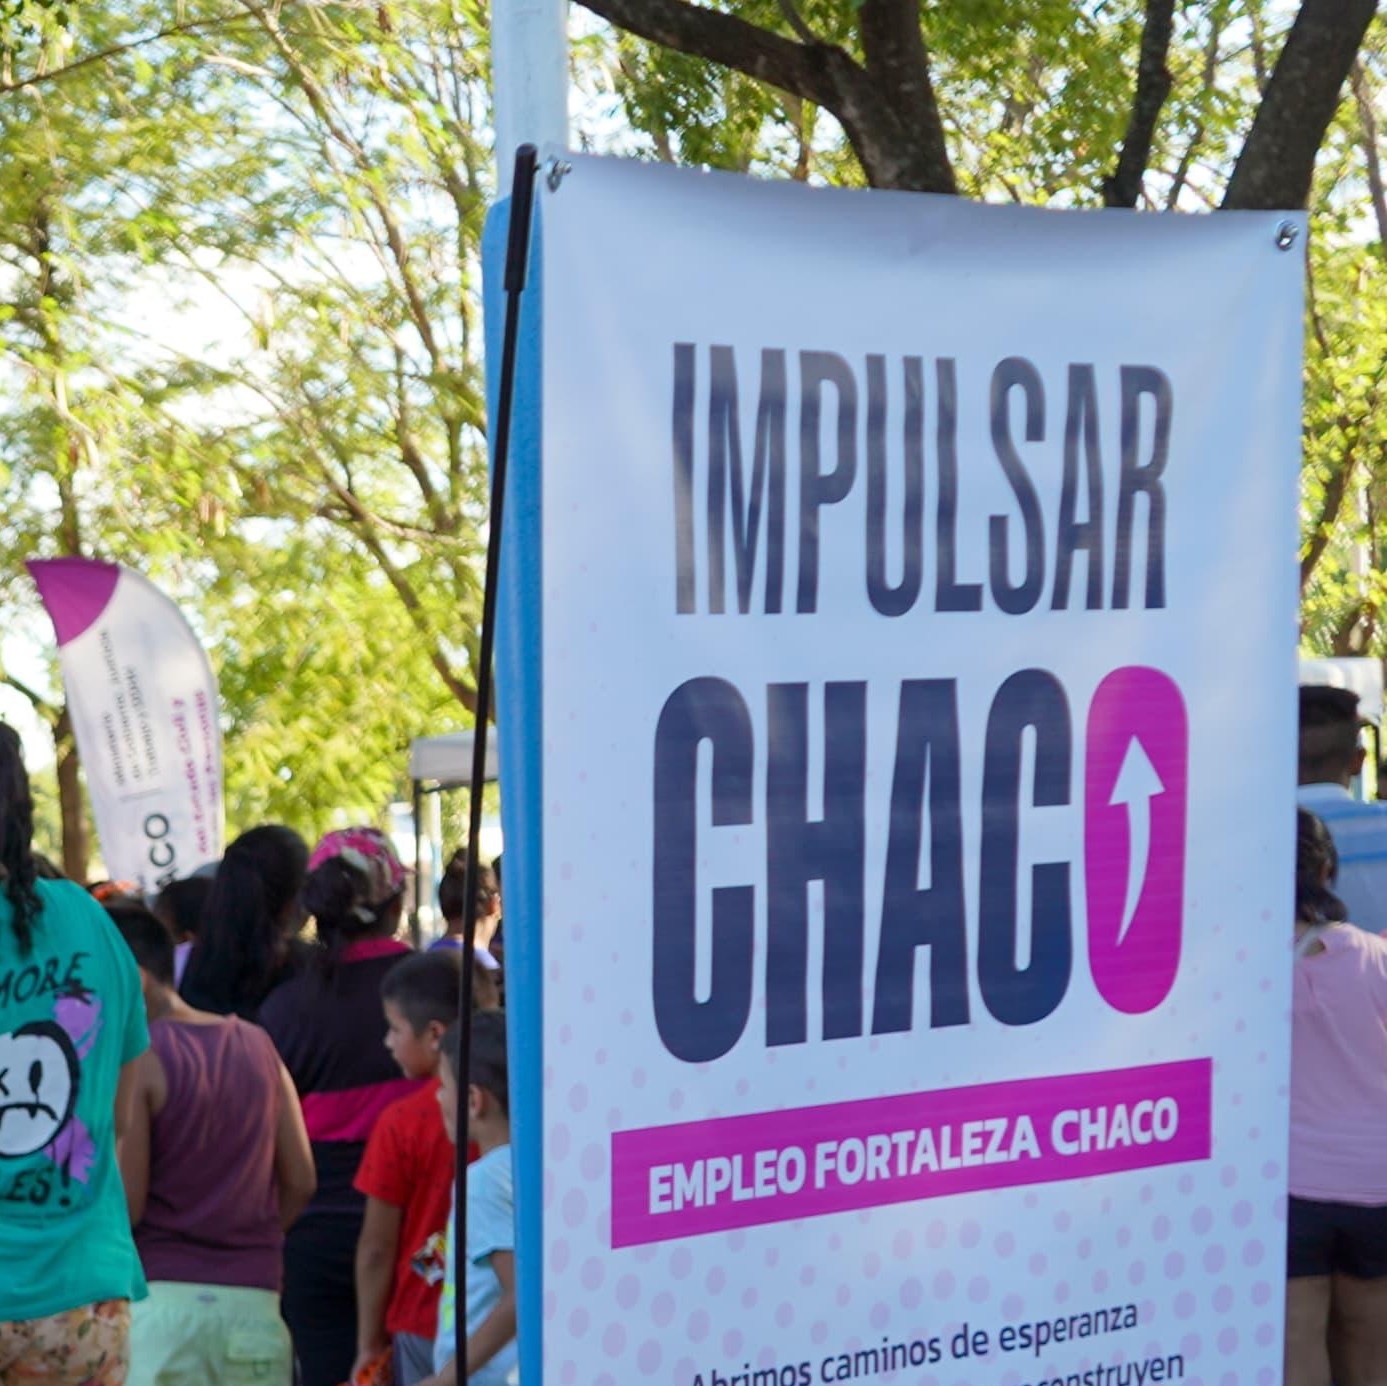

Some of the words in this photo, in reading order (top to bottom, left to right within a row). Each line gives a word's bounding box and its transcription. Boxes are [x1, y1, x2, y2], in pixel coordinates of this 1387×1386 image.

[672, 342, 1174, 617] IMPULSAR
[652, 664, 1189, 1063] CHACO
[648, 1145, 806, 1215] EMPLEO
[814, 1115, 1041, 1190] FORTALEZA
[1051, 1096, 1178, 1157] CHACO
[820, 1336, 942, 1384] caminos
[951, 1322, 989, 1360] de
[999, 1303, 1138, 1357] esperanza
